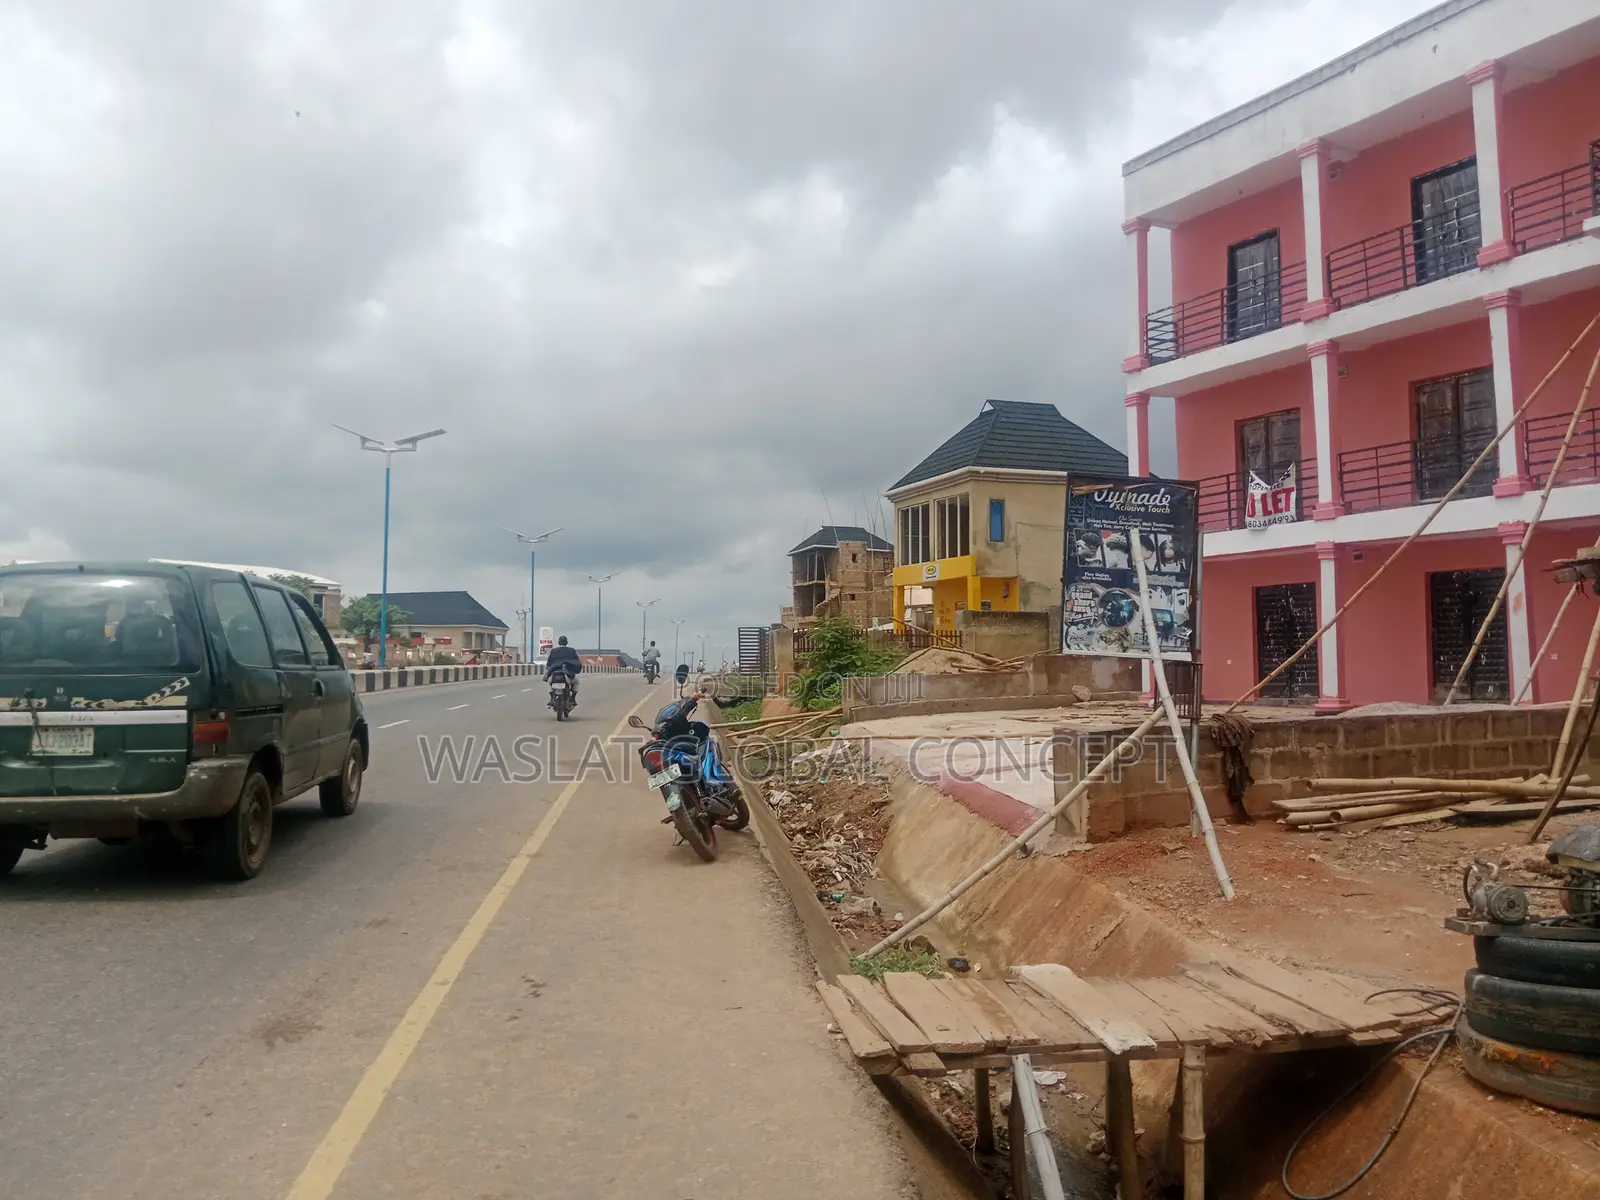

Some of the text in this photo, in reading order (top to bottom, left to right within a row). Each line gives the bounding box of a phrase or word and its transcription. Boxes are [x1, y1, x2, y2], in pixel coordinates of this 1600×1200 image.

[1115, 503, 1170, 514] Xclusive Touch
[1261, 487, 1294, 516] LET
